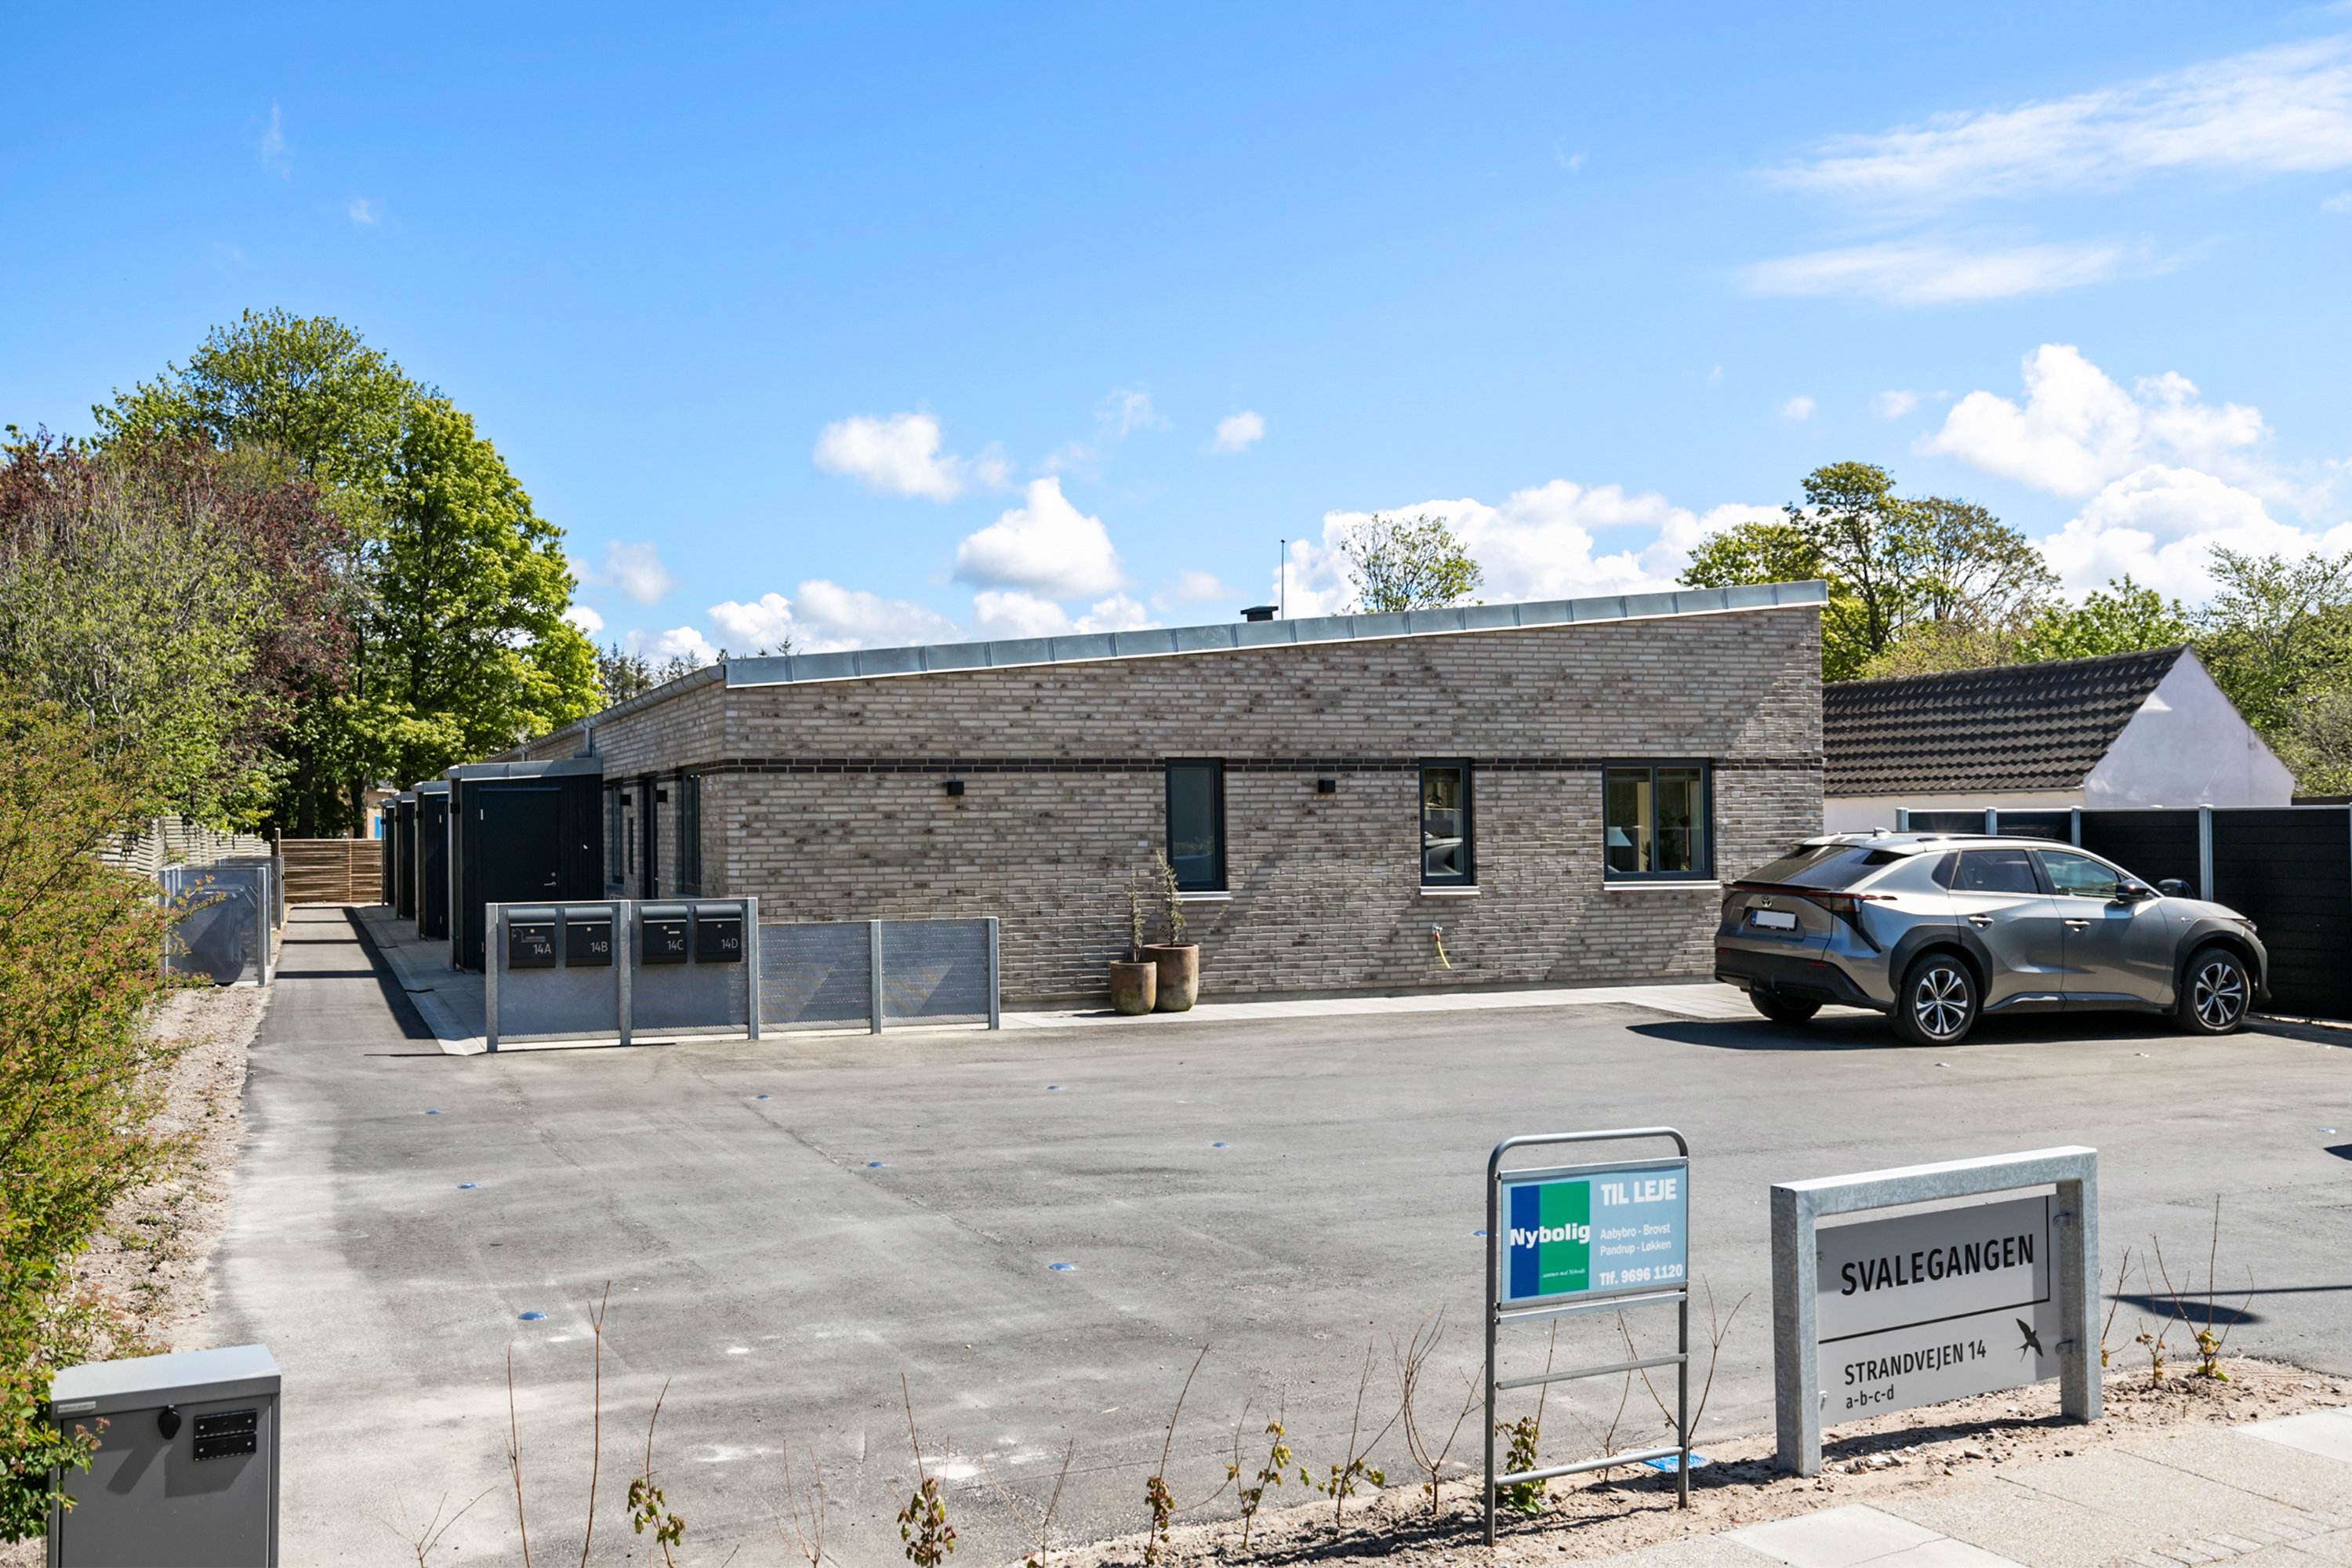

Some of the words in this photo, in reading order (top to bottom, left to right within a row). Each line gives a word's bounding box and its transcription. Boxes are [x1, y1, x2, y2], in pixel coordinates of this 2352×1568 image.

[533, 943, 552, 954] 14A
[590, 942, 608, 953] 14B
[666, 939, 684, 951] 14C
[721, 938, 739, 949] 14D
[1601, 1182, 1629, 1206] TIL
[1634, 1178, 1677, 1203] LEJE
[1510, 1222, 1590, 1249] Nybolig
[1600, 1226, 1637, 1240] Aabybro
[1643, 1223, 1671, 1236] Brovst
[1600, 1243, 1635, 1256] Pandrup
[1641, 1240, 1671, 1252] Løkken
[1599, 1271, 1618, 1286] Tlf.
[1621, 1267, 1651, 1283] 9696
[1653, 1264, 1683, 1279] 1120
[1841, 1234, 2034, 1297] SVALEGANGEN
[1845, 1342, 1963, 1385] STRANDVEJEN
[1968, 1339, 1987, 1360] 14
[1846, 1385, 1894, 1409] a-b-c-d
